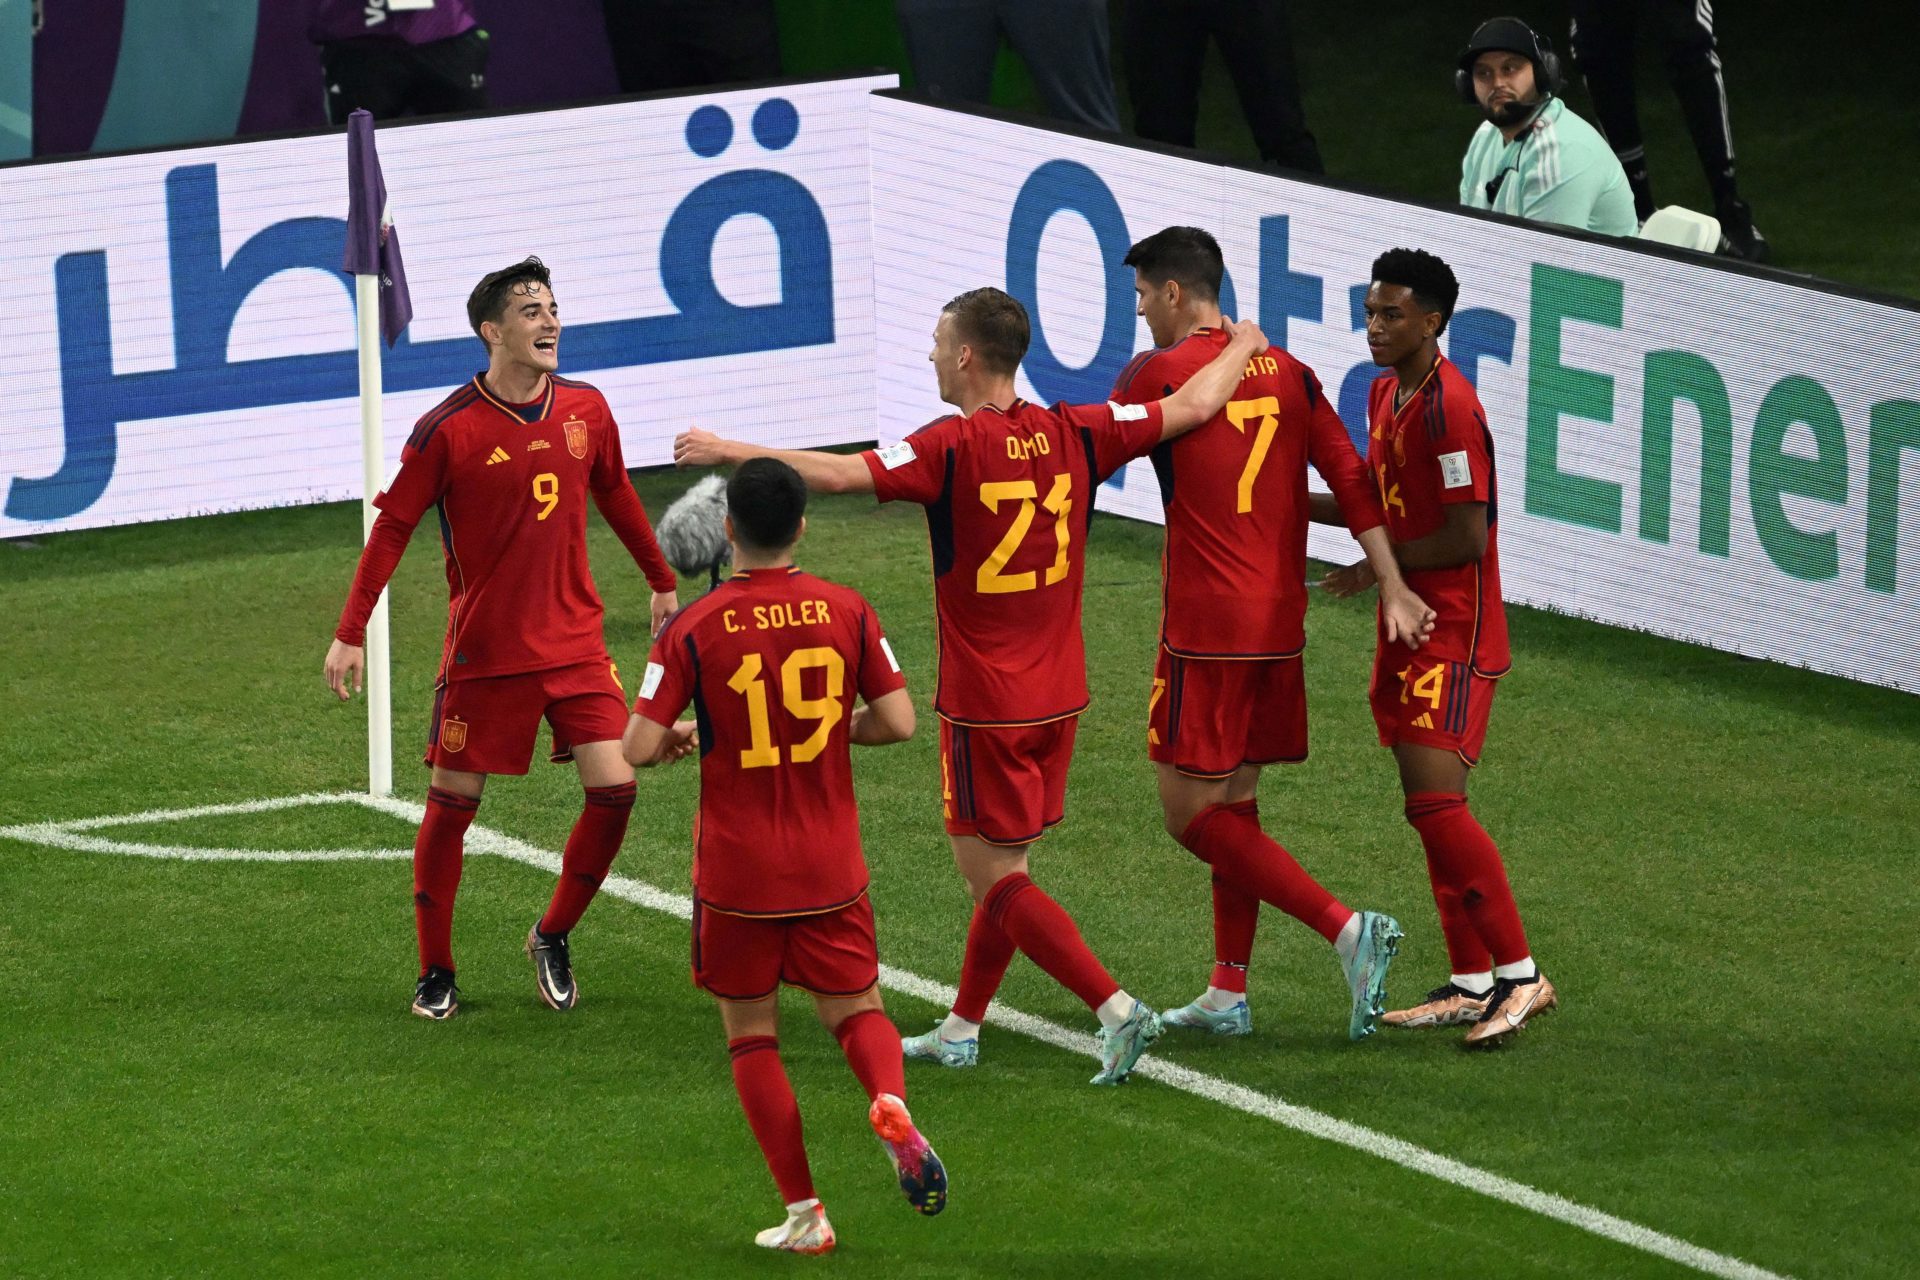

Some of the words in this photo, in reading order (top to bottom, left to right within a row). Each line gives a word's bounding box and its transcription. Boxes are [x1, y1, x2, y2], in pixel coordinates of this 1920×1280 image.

[3, 98, 835, 521] قطر
[1241, 356, 1279, 381] ATA
[1006, 432, 1050, 460] OLMO
[1226, 396, 1280, 513] 7
[532, 472, 559, 521] 9
[976, 472, 1073, 594] 21
[723, 609, 746, 633] C.
[753, 600, 831, 630] SOLER
[727, 646, 845, 769] 19
[1397, 662, 1445, 710] 14
